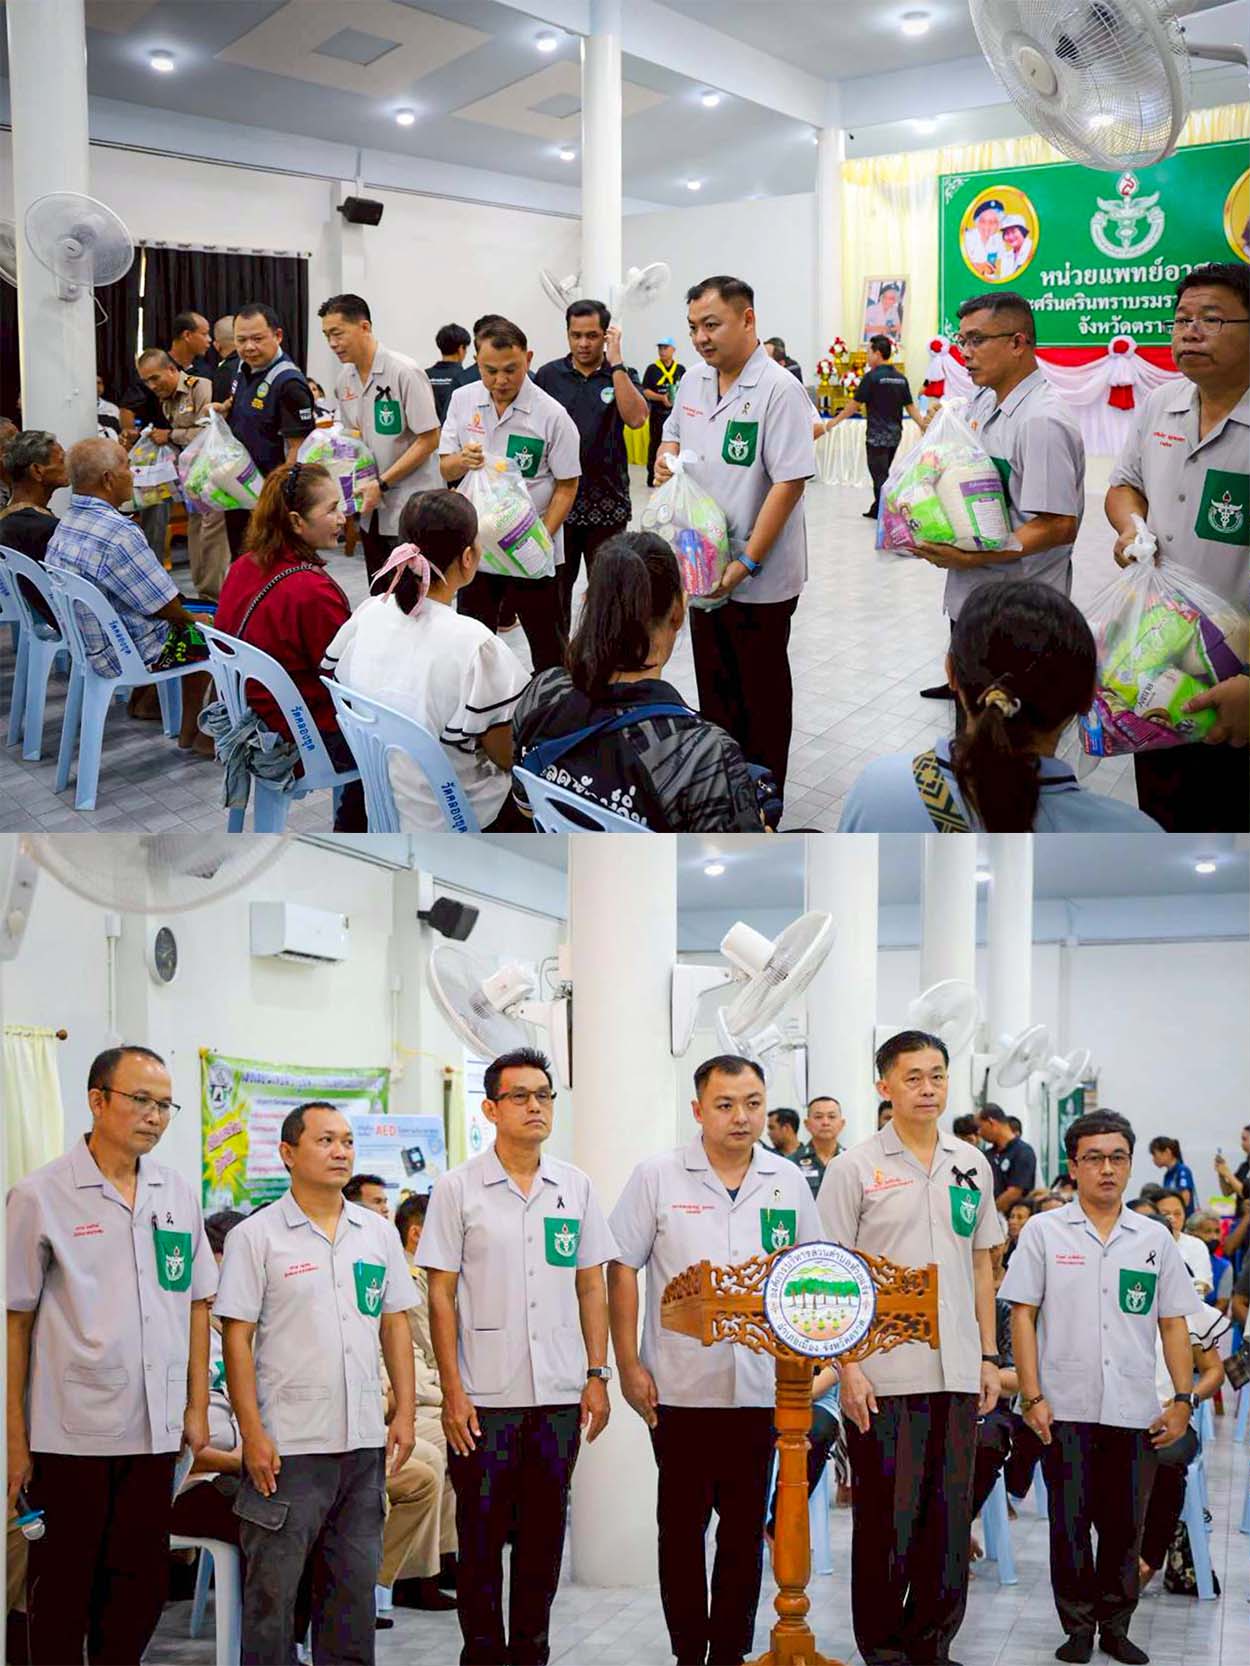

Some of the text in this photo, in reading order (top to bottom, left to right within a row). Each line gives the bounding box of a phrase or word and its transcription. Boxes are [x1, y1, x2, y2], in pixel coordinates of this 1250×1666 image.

[1040, 256, 1214, 286] หน่วยแพทย์อา
